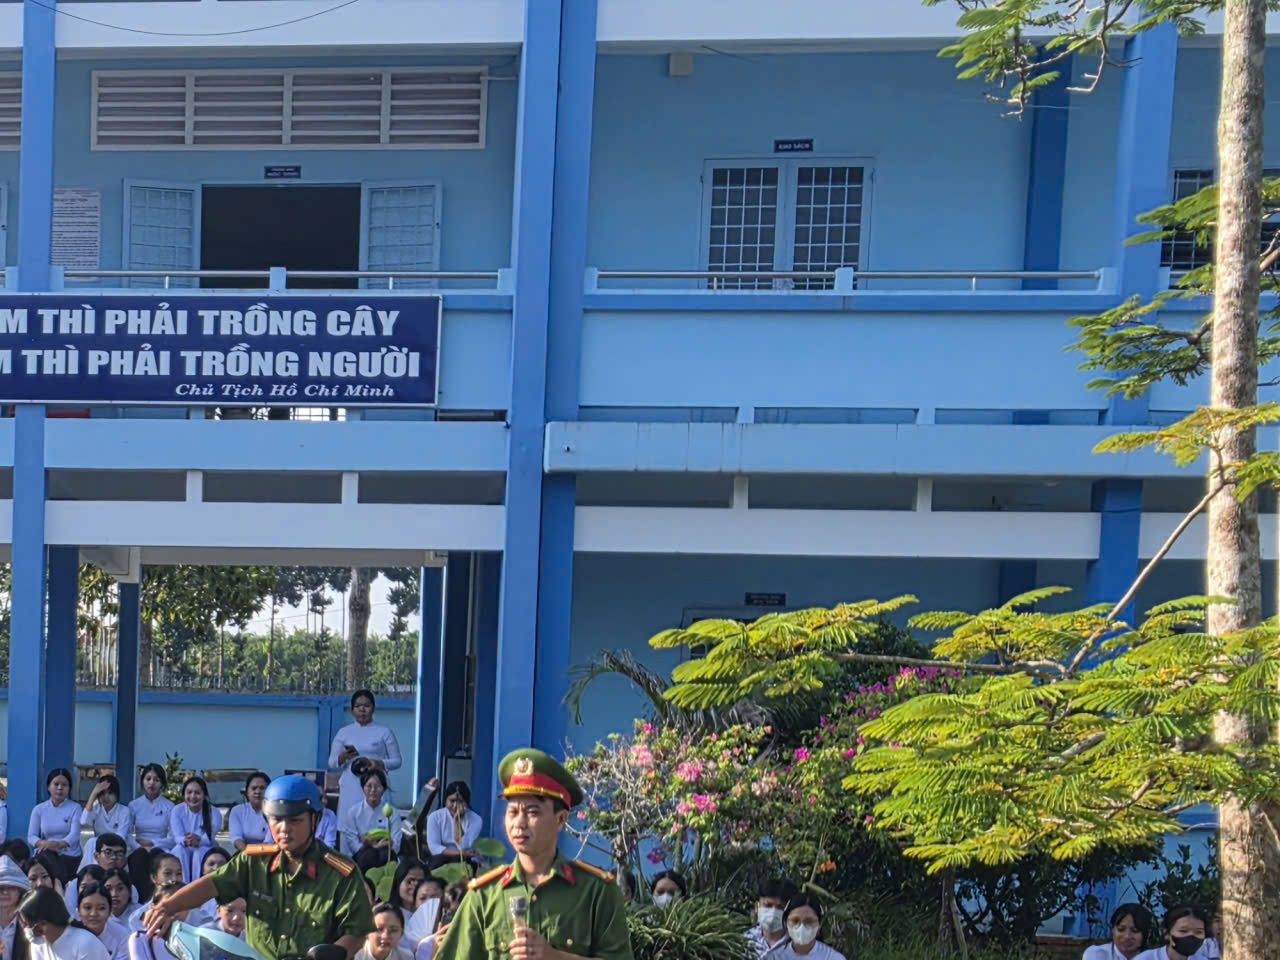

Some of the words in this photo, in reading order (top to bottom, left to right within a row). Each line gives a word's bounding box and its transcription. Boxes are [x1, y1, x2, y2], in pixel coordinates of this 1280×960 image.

[37, 304, 96, 335] THÌ
[104, 302, 188, 336] PHẢI
[197, 303, 317, 336] TRỒNG
[326, 304, 401, 336] CÂY
[21, 344, 79, 375] THÌ
[87, 343, 171, 376] PHẢI
[180, 342, 299, 377] TRỒNG
[308, 345, 420, 378] NGƯỜI
[175, 383, 214, 396] Chủ
[221, 383, 263, 398] Tịch
[269, 382, 298, 397] Hồ
[304, 384, 340, 397] Chí
[344, 384, 395, 397] Minh
